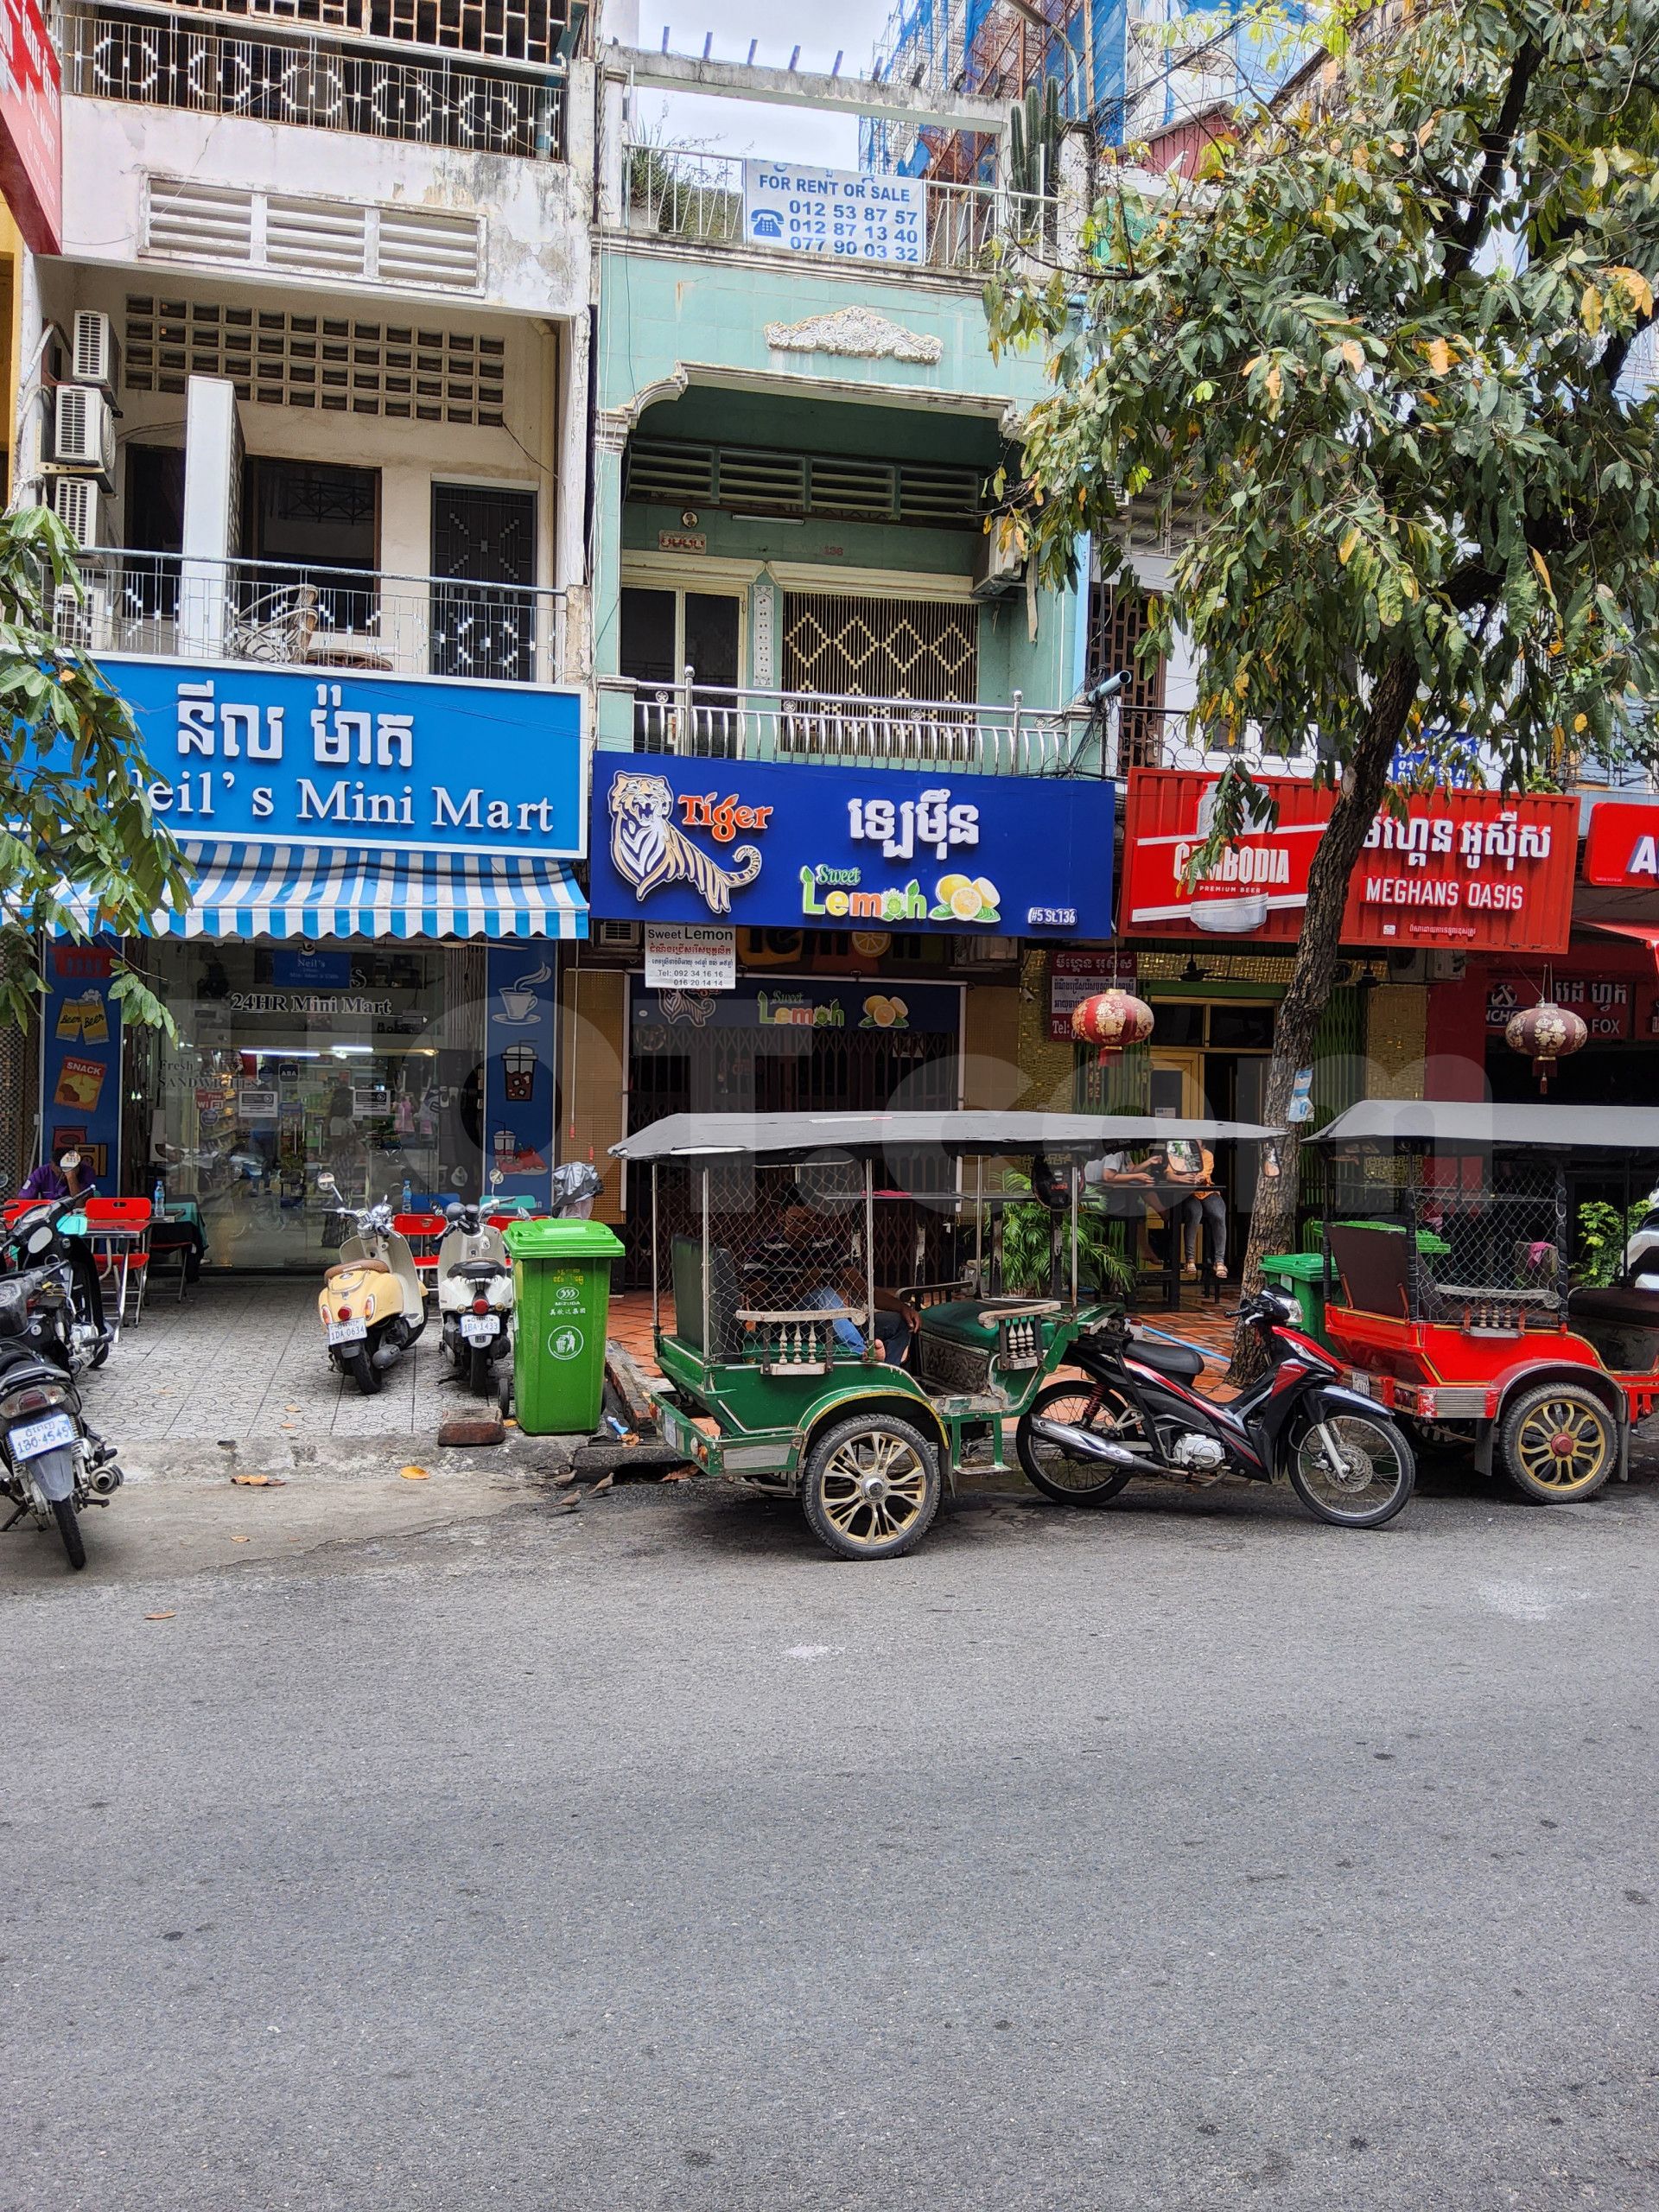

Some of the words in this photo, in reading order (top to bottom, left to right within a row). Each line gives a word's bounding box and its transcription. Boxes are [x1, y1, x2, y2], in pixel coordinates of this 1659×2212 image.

[760, 175, 791, 190] FOR
[797, 178, 838, 195] RENT
[843, 183, 866, 198] OR
[871, 186, 910, 202] SALE
[790, 200, 825, 216] 012
[833, 205, 856, 219] 53
[864, 207, 887, 222] 87
[894, 211, 918, 225] 57
[790, 219, 825, 234] 012
[833, 223, 856, 237] 87
[865, 226, 887, 240] 13
[894, 229, 918, 244] 40
[790, 237, 825, 251] 077
[833, 240, 857, 255] 90
[864, 243, 887, 257] 03
[894, 246, 918, 262] 32
[297, 779, 415, 824] Mini
[432, 786, 554, 832] Mart
[678, 791, 774, 843] Tiger
[817, 864, 861, 886] Sweet
[800, 865, 927, 922] Lemon
[1366, 877, 1459, 906] MEGHANS
[1468, 882, 1523, 909] OASIS
[1032, 909, 1044, 922] #5
[648, 929, 681, 939] Sweet
[685, 927, 733, 940] Lemon
[297, 958, 326, 968] Neil's
[232, 993, 288, 1012] 24HR
[291, 995, 339, 1014] Mini
[341, 997, 392, 1015] Mart
[84, 1014, 105, 1028] Beer
[1052, 1020, 1070, 1034] Tel:
[1592, 1019, 1620, 1034] FOX
[66, 1061, 102, 1077] SNACK
[159, 1059, 194, 1071] Fresh
